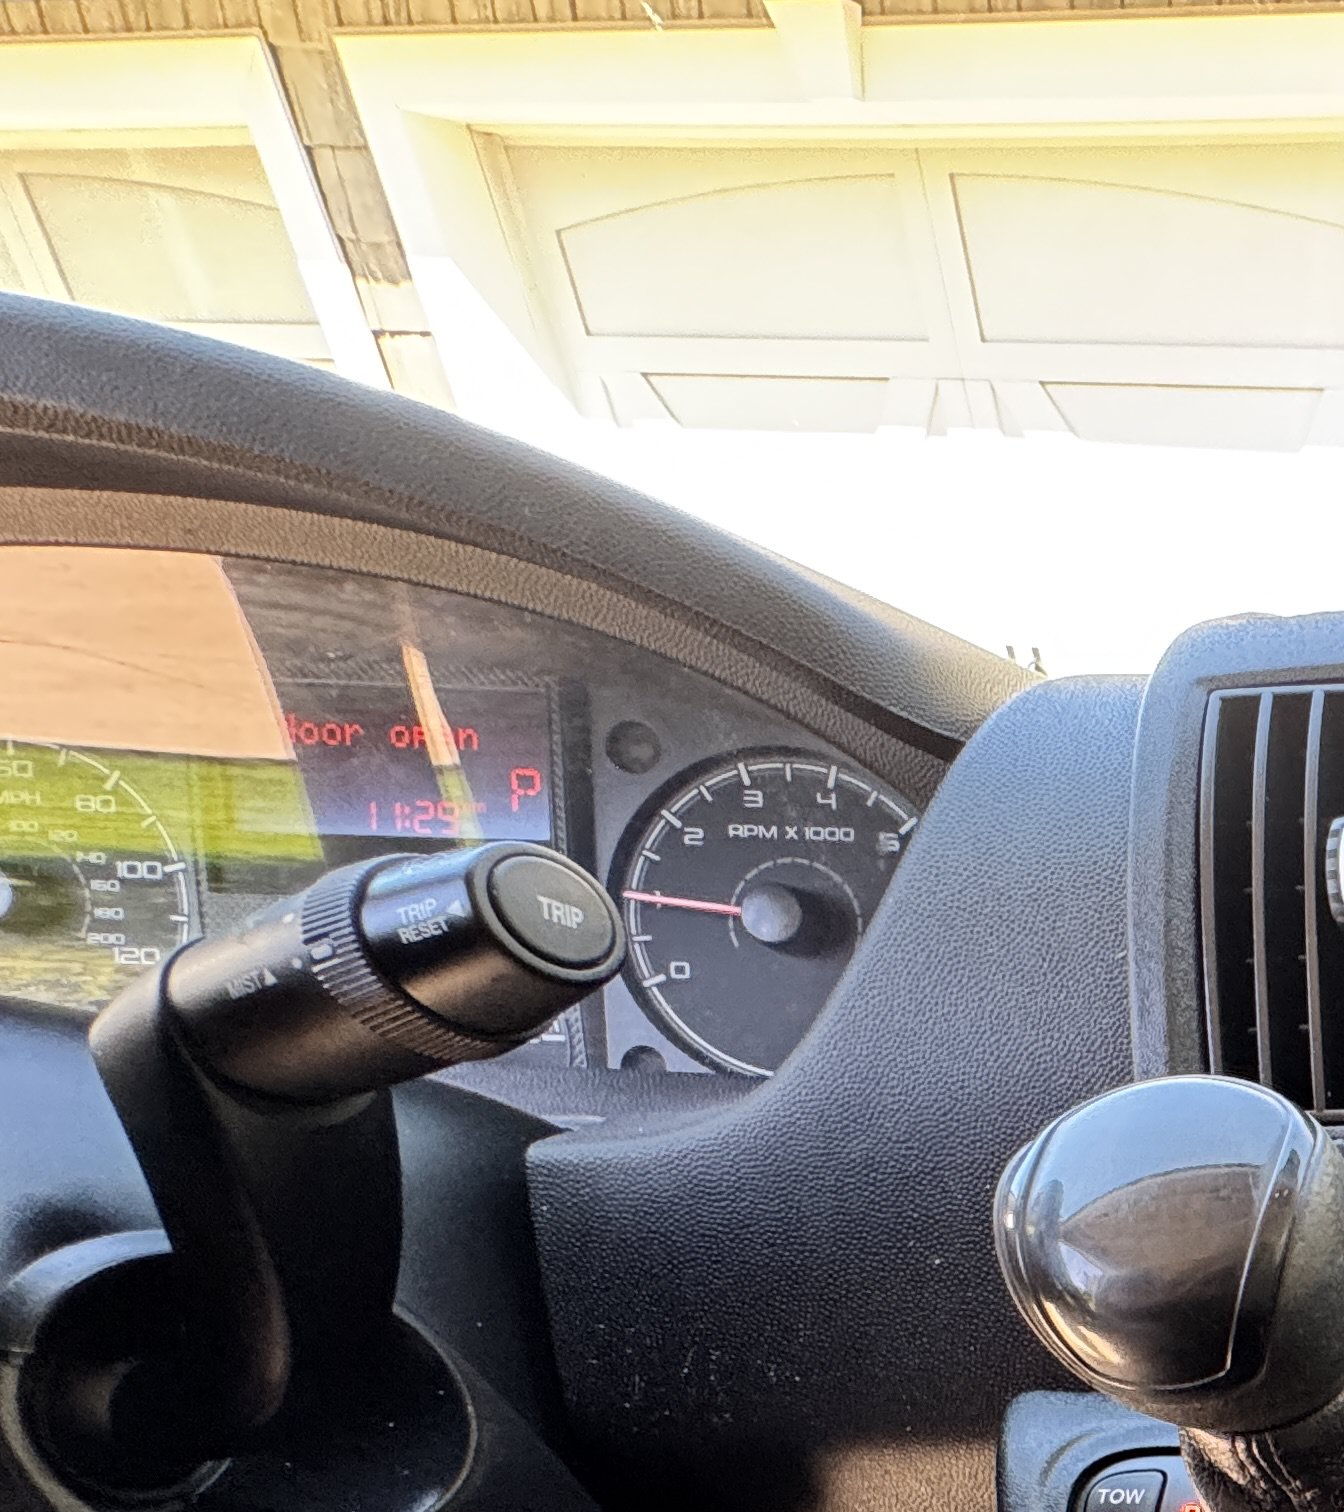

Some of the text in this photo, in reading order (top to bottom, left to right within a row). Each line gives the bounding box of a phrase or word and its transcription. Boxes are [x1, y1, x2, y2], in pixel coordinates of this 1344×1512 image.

[389, 725, 479, 750] opn
[509, 767, 541, 812] P
[75, 795, 116, 813] 80
[743, 790, 763, 808] 3
[816, 792, 837, 811] 4
[683, 827, 704, 846] 2
[728, 824, 855, 842] RPM X 1000
[878, 831, 900, 852] 5
[115, 861, 163, 879] 100
[396, 898, 438, 924] TRIP
[537, 895, 584, 929] TRIP
[86, 932, 125, 945] 200
[399, 915, 452, 945] RESET
[112, 947, 160, 965] 120
[670, 961, 690, 979] 0
[1098, 1488, 1145, 1505] TOW
